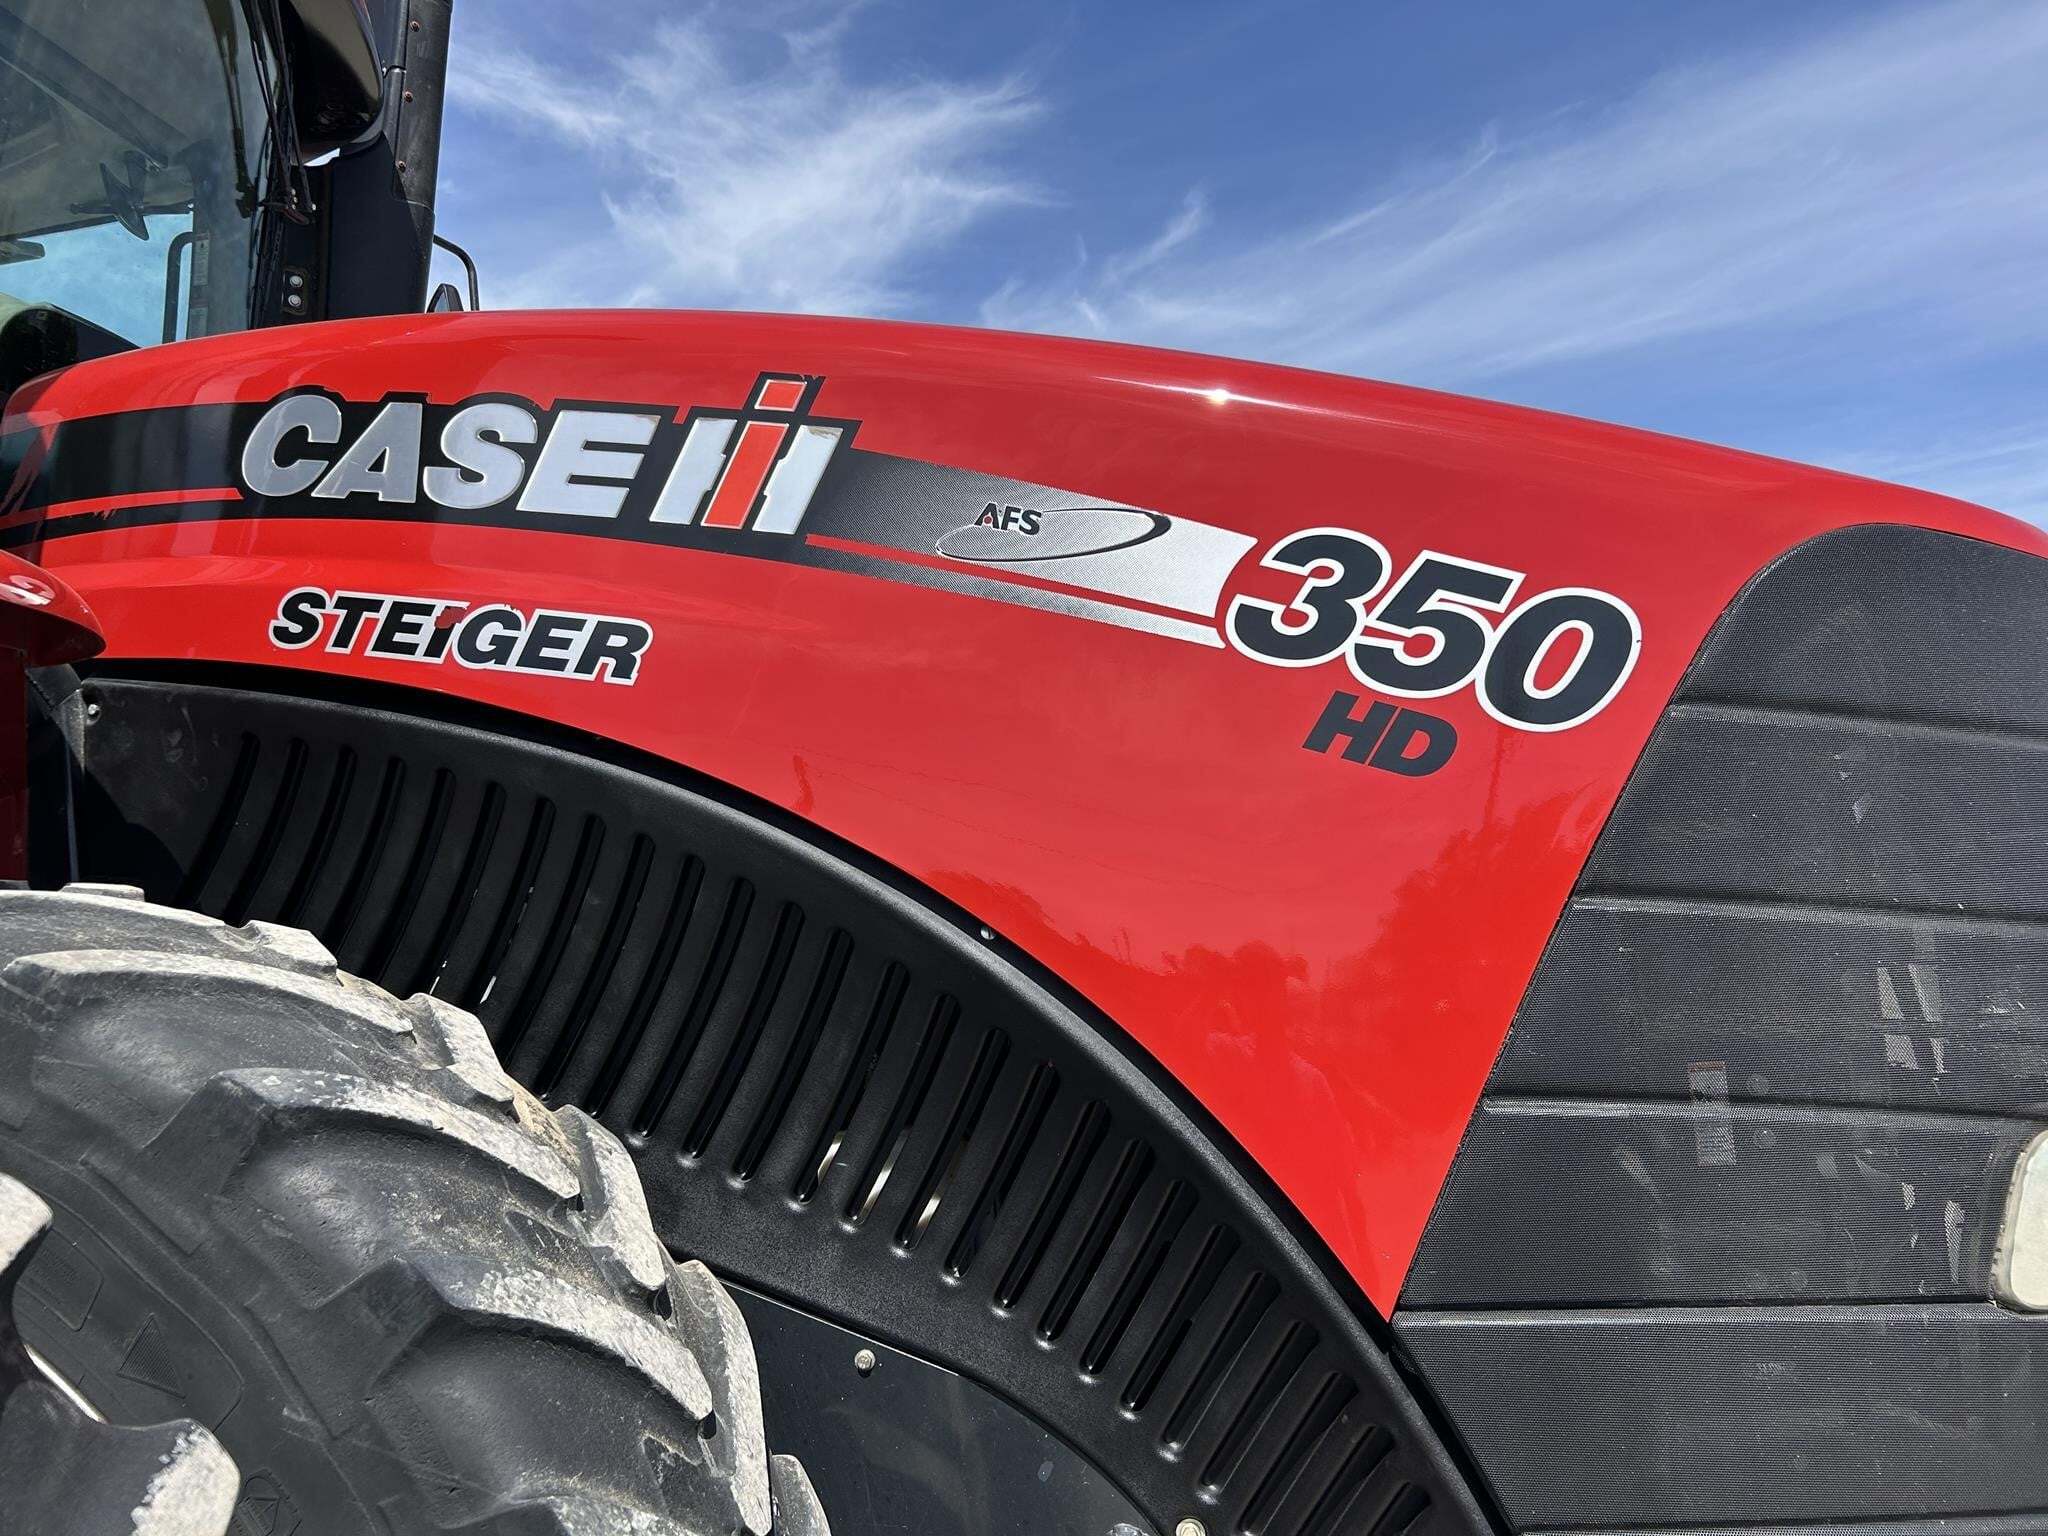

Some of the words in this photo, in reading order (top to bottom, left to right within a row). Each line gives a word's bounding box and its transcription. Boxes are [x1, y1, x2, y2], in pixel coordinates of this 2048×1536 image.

[242, 394, 661, 518] CASE
[974, 502, 1042, 536] AFS
[270, 588, 652, 684] STEIGER
[1227, 528, 1641, 732] 350
[1302, 691, 1457, 777] HD
